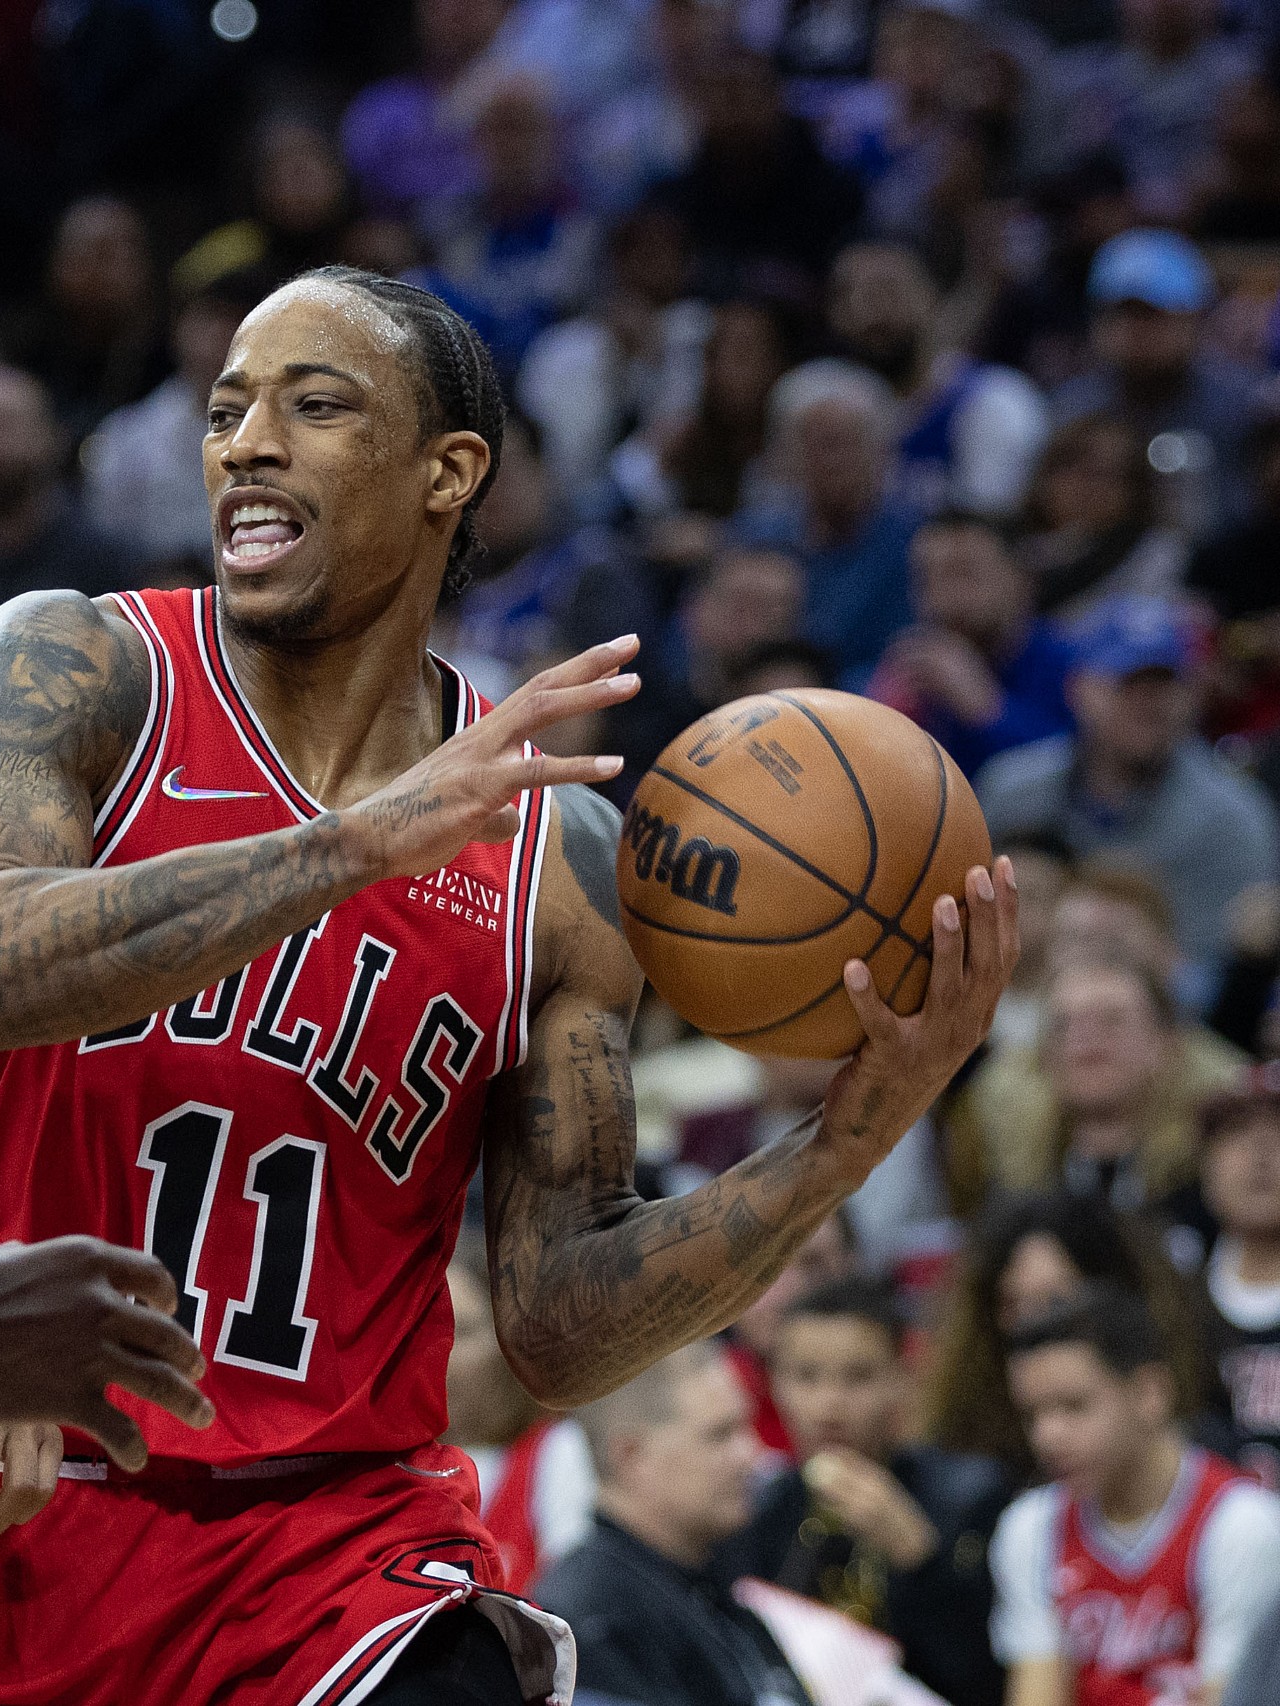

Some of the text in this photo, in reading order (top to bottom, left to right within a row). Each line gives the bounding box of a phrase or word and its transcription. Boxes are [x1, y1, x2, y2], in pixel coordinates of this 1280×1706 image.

[408, 887, 497, 931] EYEWEAR
[77, 910, 484, 1185] ULLS
[136, 1100, 326, 1382] 11
